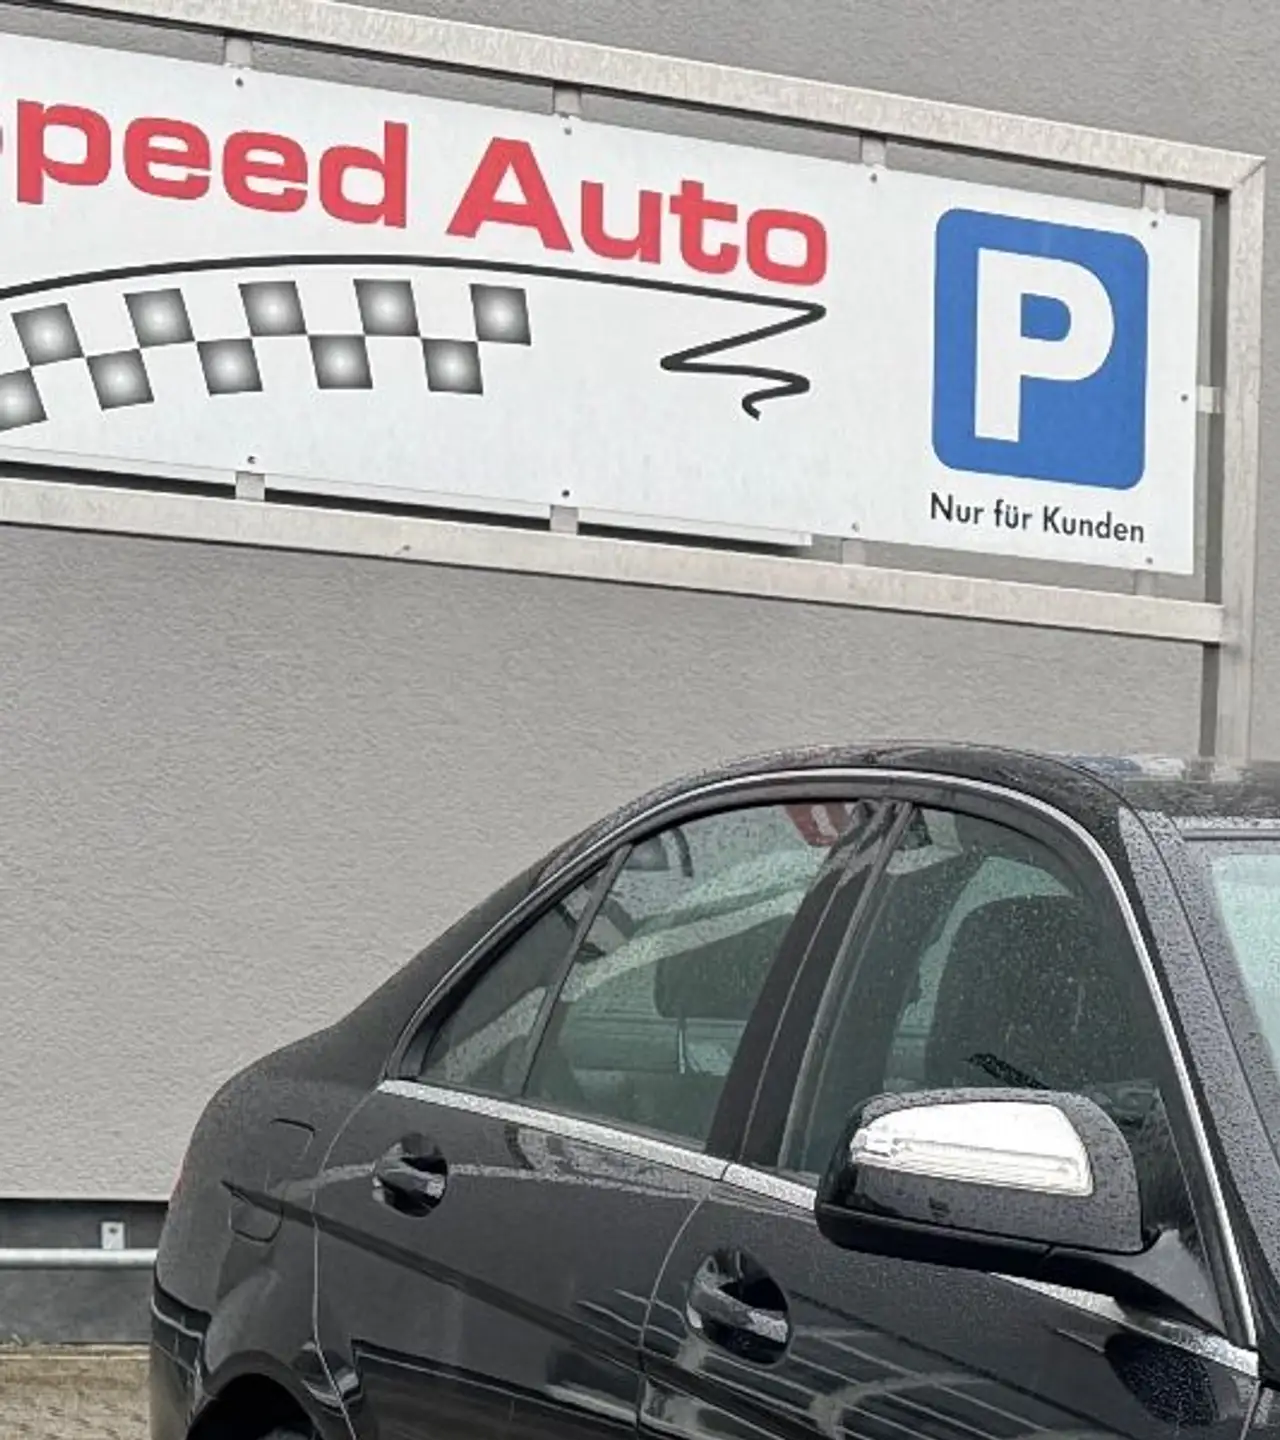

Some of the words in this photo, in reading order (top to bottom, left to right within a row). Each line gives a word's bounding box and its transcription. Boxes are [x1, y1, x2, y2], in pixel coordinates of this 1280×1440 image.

[0, 99, 409, 229] peed
[447, 136, 829, 288] Auto
[974, 247, 1116, 443] P
[930, 492, 985, 525] Nur
[993, 498, 1033, 530] für
[1043, 505, 1145, 543] Kunden
